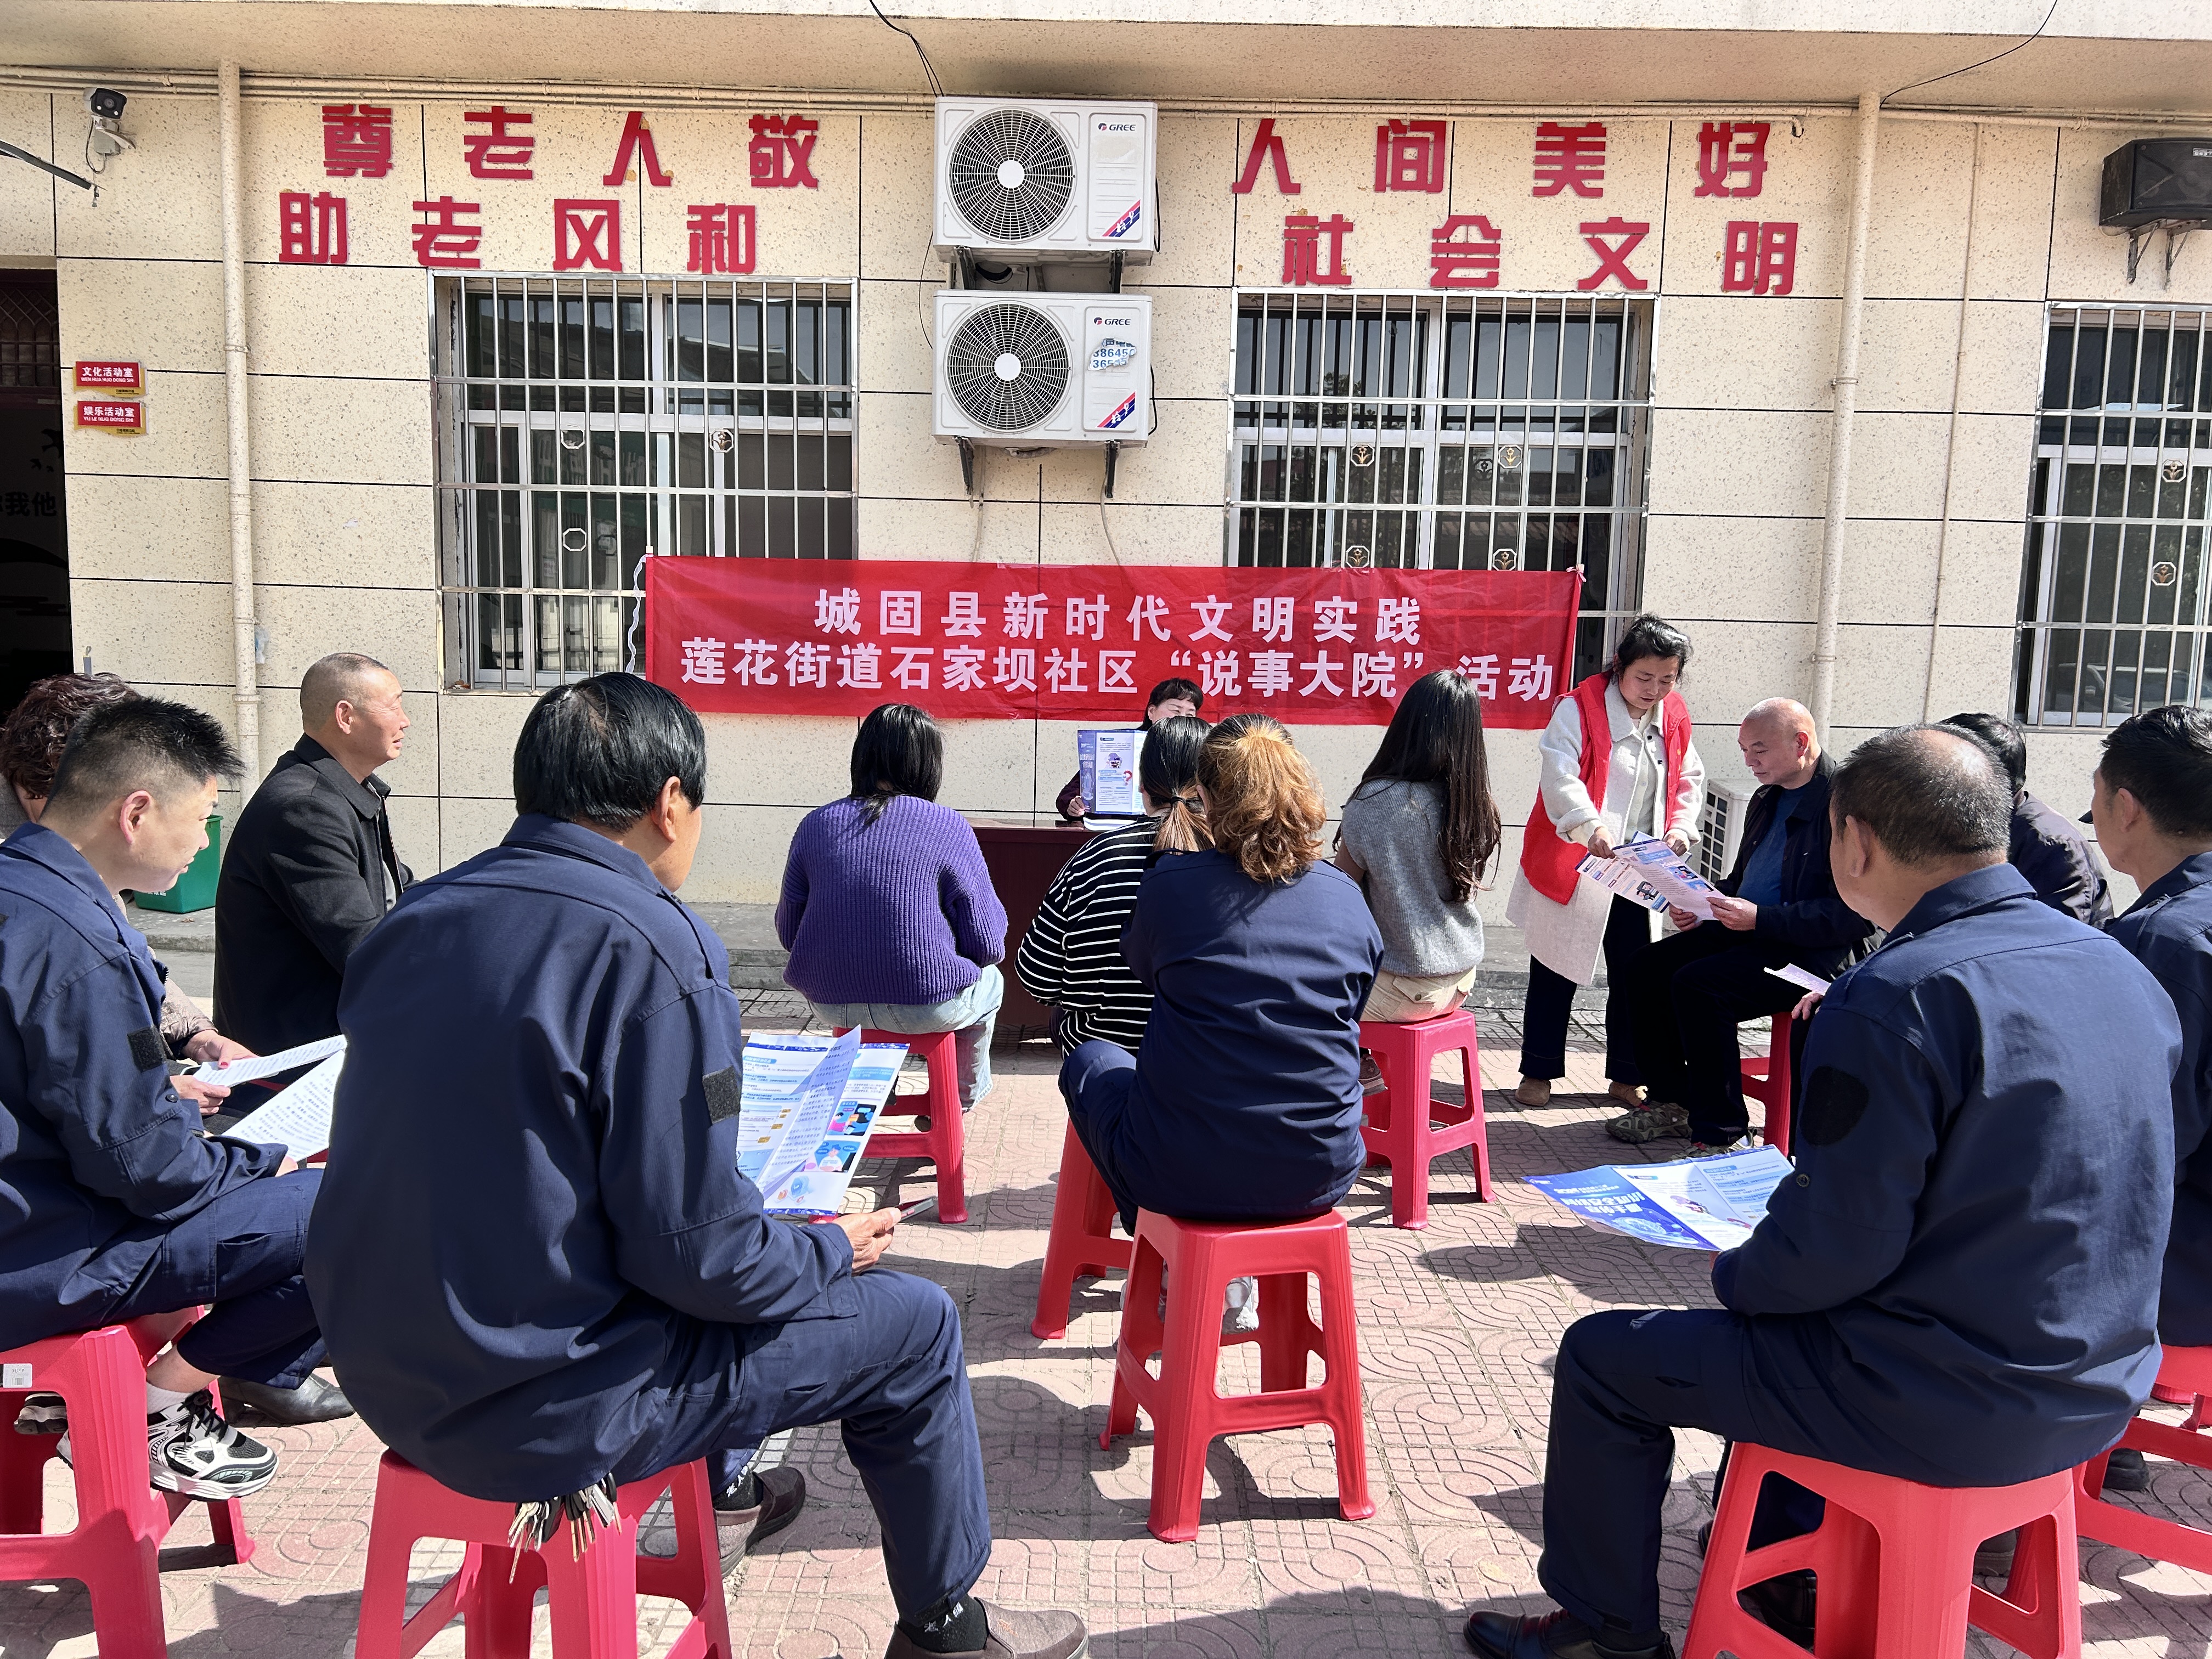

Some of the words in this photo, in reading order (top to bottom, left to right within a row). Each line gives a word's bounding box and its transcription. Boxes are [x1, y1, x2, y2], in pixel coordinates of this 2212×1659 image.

[82, 366, 133, 377] 文化活动室
[83, 406, 135, 417] 娱乐活动室
[0, 491, 57, 517] 我他
[814, 587, 1421, 646] 城固县新时代文明实践
